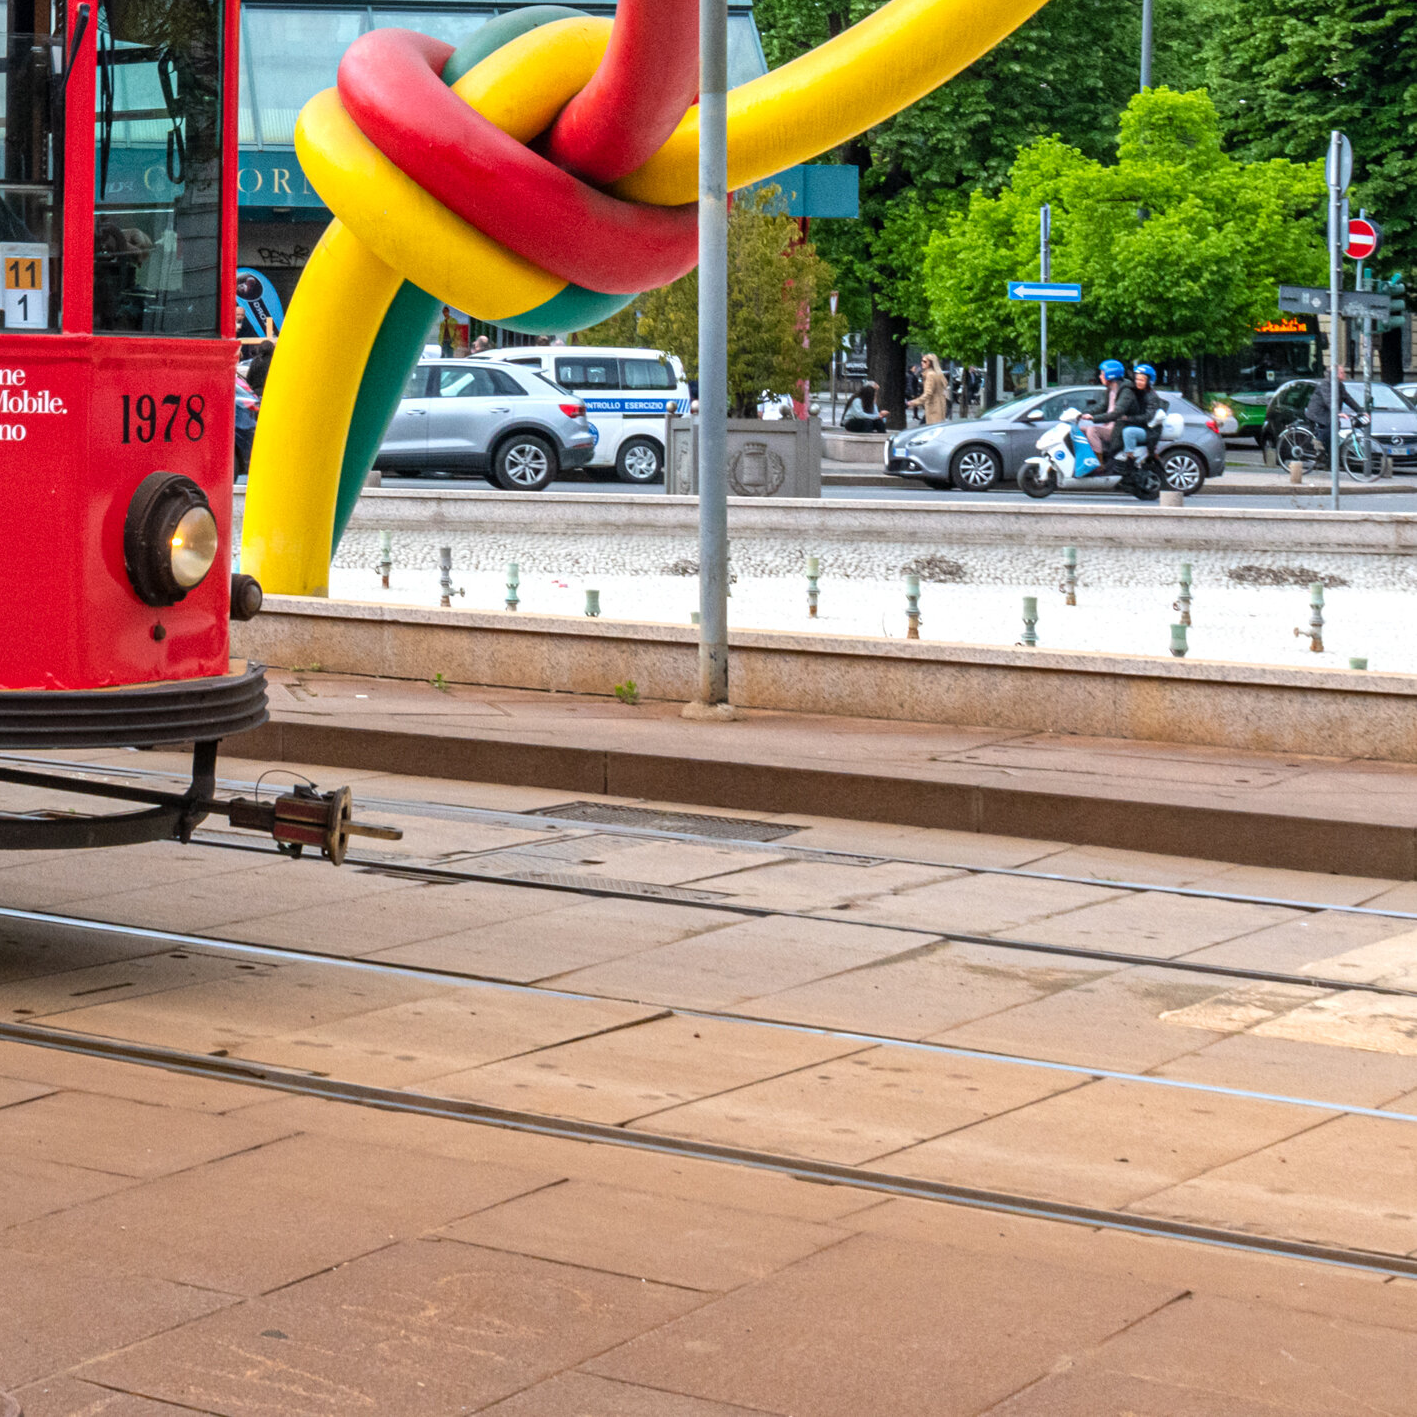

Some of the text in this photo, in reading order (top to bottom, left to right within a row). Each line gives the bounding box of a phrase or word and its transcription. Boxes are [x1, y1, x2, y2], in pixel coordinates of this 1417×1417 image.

[9, 260, 35, 288] 11
[17, 294, 28, 321] 1
[121, 393, 205, 445] 1978
[624, 401, 664, 410] ESERCIZIO
